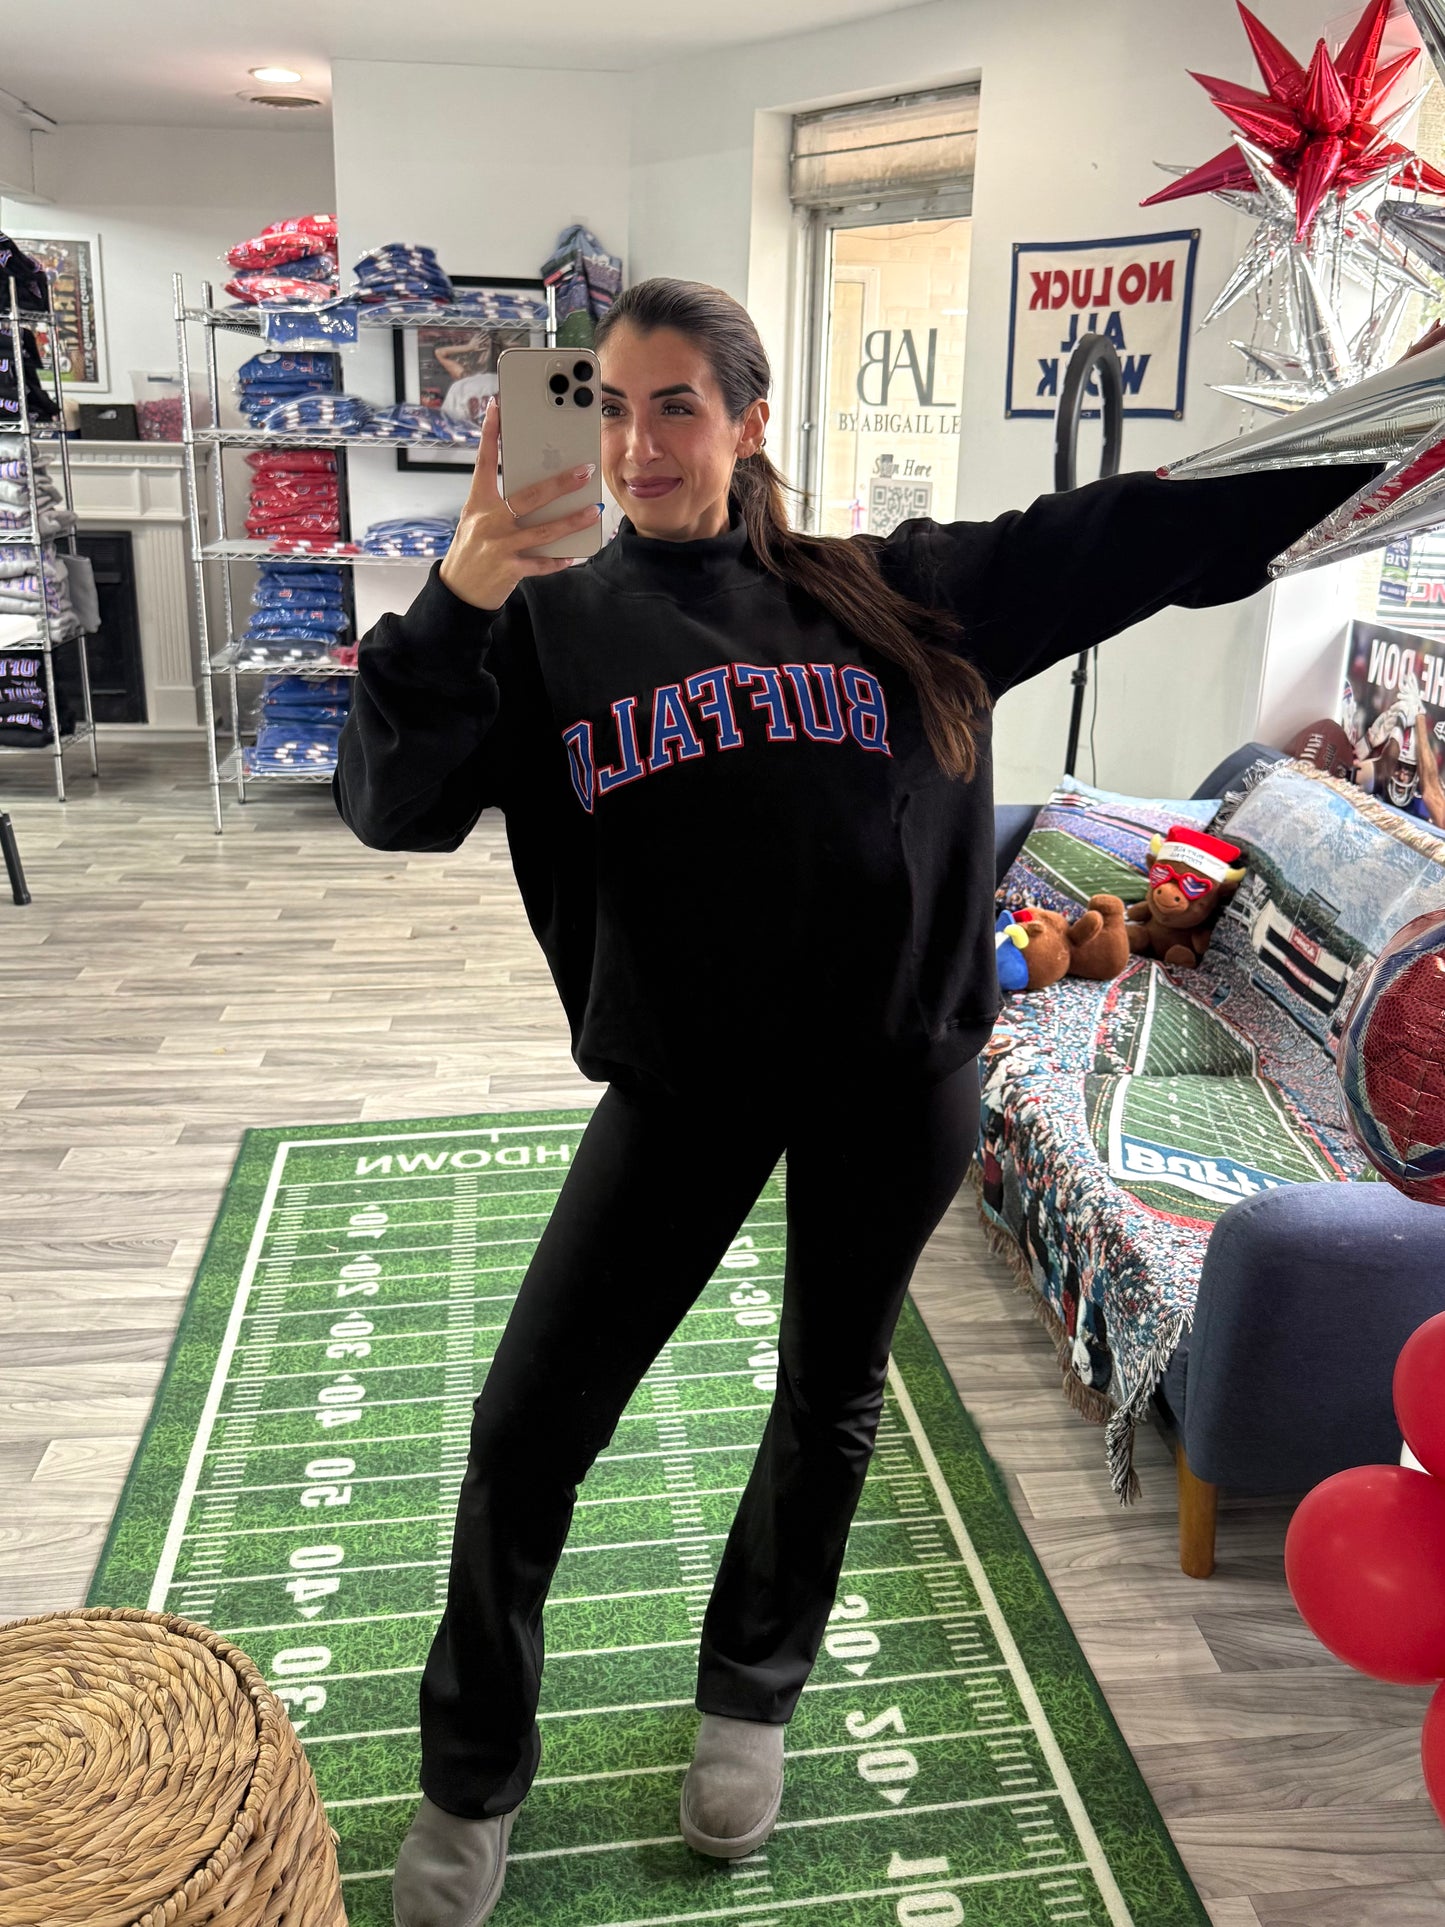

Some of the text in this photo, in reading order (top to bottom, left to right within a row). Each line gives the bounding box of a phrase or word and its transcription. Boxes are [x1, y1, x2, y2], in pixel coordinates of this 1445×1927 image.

[838, 413, 858, 432] BY
[861, 413, 934, 434] ABIGAIL
[872, 456, 932, 478] Sn Here
